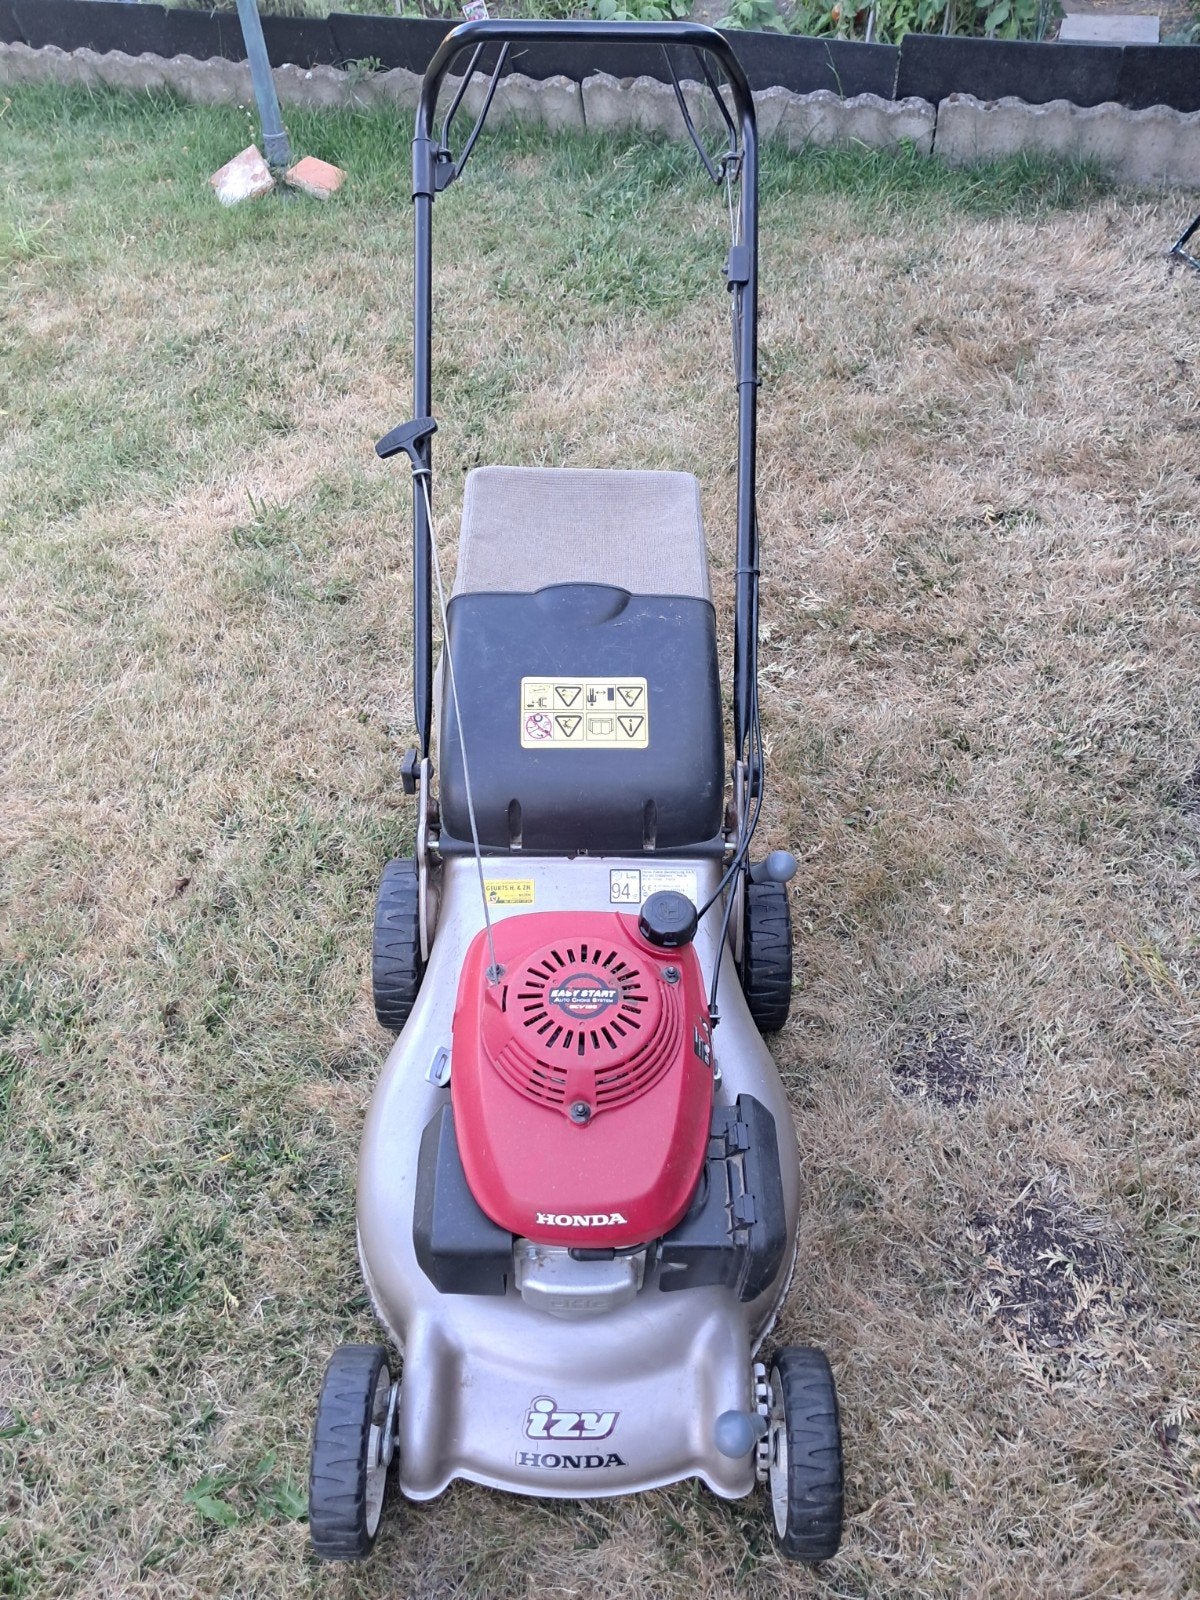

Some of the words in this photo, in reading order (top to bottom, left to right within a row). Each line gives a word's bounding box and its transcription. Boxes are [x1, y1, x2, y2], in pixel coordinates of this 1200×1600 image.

[611, 882, 631, 899] 94
[580, 989, 616, 998] START
[536, 1212, 628, 1227] HONDA
[518, 1451, 626, 1469] HONDA
